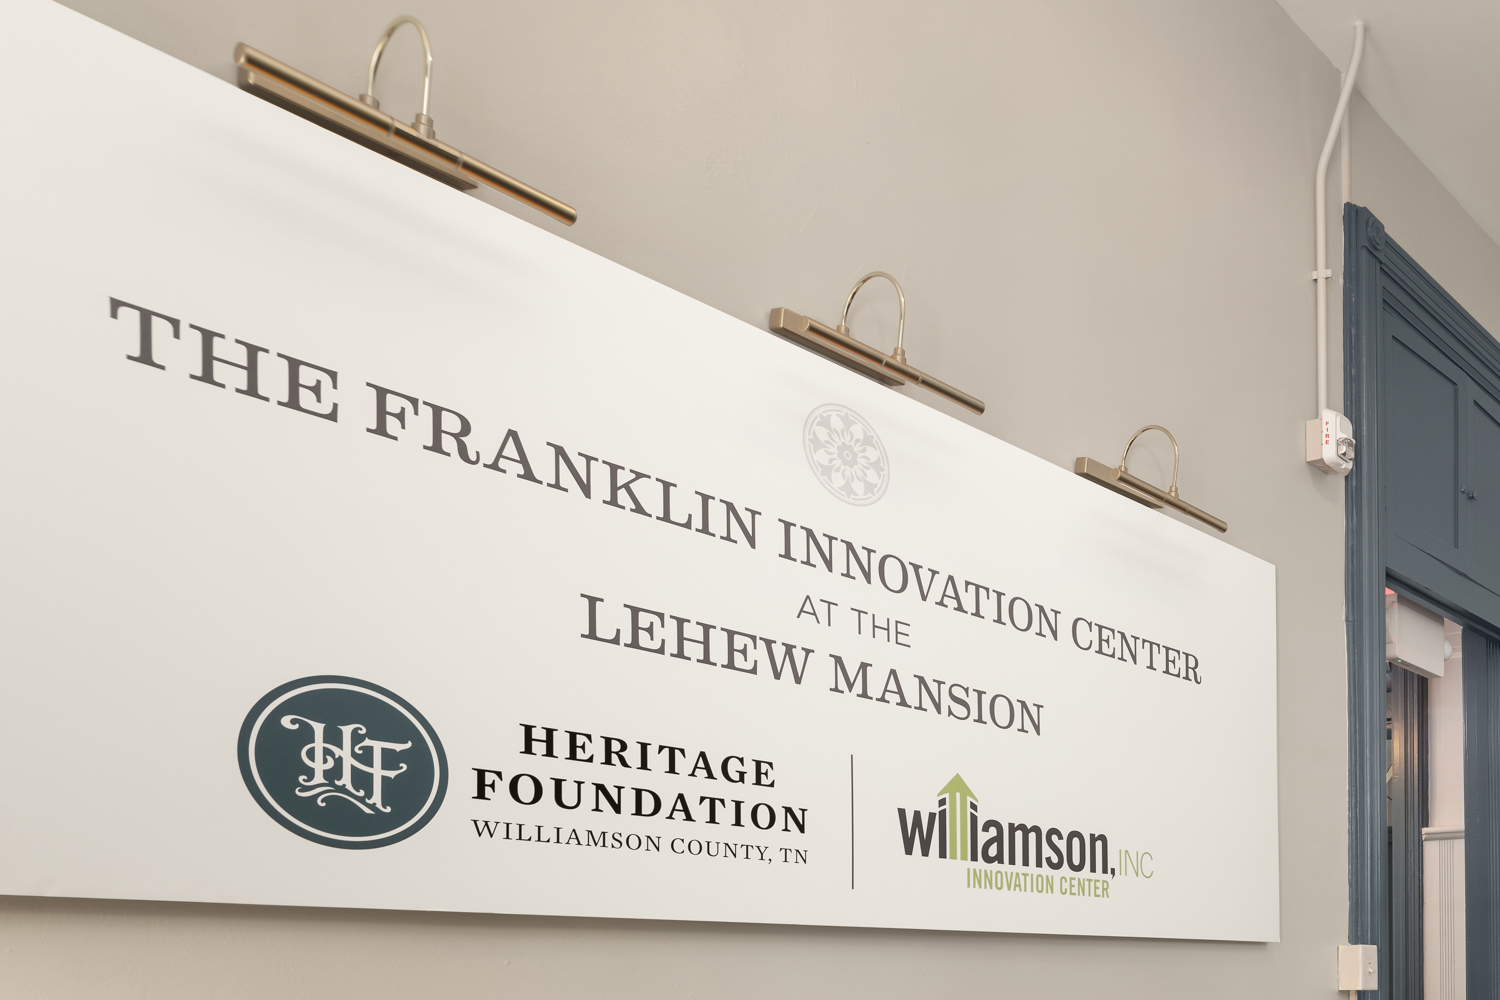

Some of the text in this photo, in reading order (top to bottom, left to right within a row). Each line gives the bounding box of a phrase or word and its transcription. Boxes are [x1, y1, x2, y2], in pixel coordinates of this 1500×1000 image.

[109, 296, 1203, 685] THE FRANKLIN INNOVATION CENTER
[796, 594, 911, 648] AT THE
[579, 592, 1044, 737] LEHEW MANSION
[519, 722, 776, 788] HERITAGE
[471, 767, 809, 835] FOUNDATION
[471, 819, 809, 866] WILLIAMSON COUNTY, TN
[1118, 848, 1154, 878] INC
[966, 867, 1110, 899] INNOVATION CENTER
